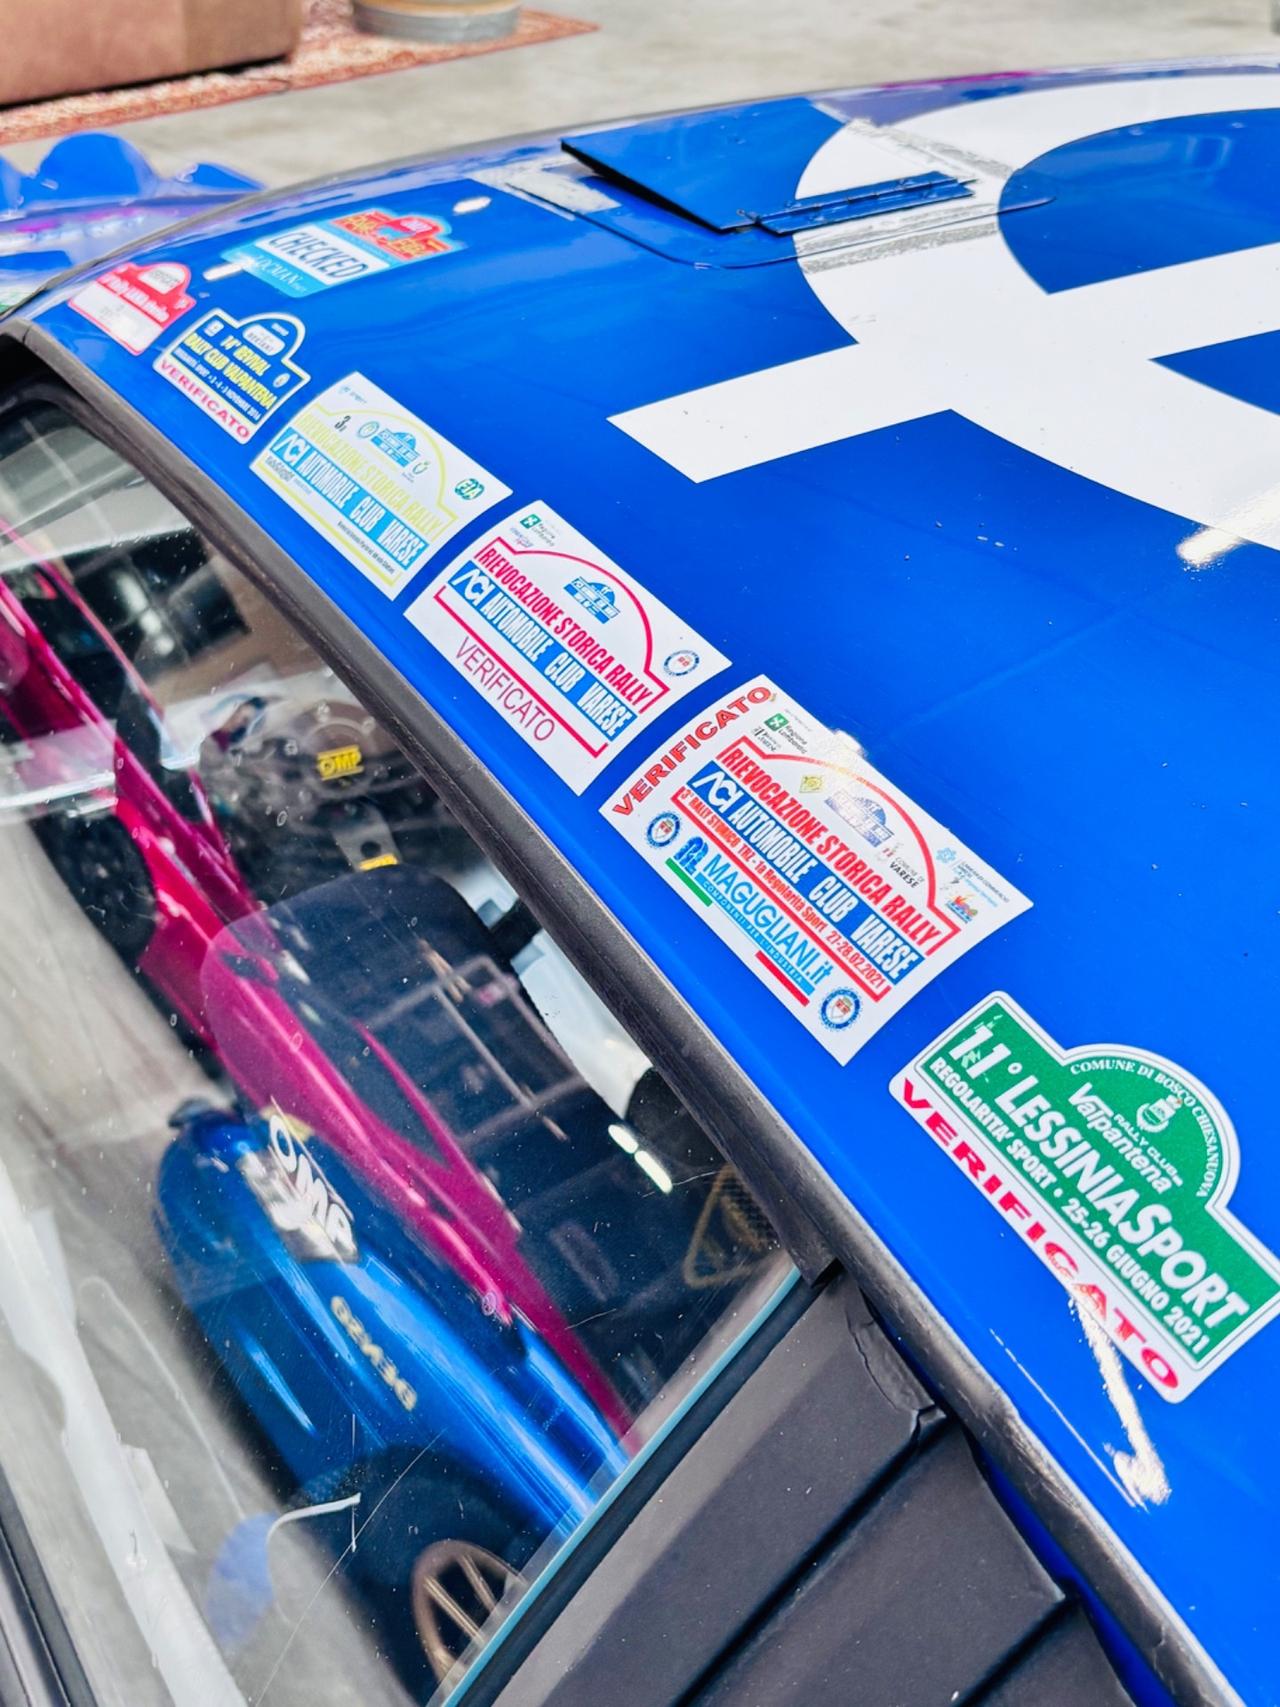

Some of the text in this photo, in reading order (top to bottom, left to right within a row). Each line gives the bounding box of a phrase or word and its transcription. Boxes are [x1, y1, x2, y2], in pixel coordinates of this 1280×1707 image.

[268, 232, 370, 279] CHECKED
[160, 359, 250, 438] VERIFICATO
[182, 331, 279, 410] RALLY CLUB VALPANTENA
[272, 431, 311, 466] ACI
[295, 450, 360, 509] AUTOMOBILE
[348, 494, 388, 534] CLUB
[375, 517, 424, 566] VARESE
[358, 462, 413, 511] STORICA
[401, 499, 443, 537] RALLY
[451, 568, 497, 607] ACI
[480, 591, 555, 663] AUTOMOBILE
[544, 652, 587, 694] CLUB
[576, 681, 633, 738] VARESE
[455, 635, 555, 742] VERIFICATO
[478, 548, 565, 626] RIEVOCAZIONE
[554, 617, 616, 675] STORICA
[605, 664, 653, 706] RALLY
[612, 686, 772, 816] VERIFICATO
[687, 797, 712, 821] RALLY
[800, 904, 829, 934] Sport
[825, 929, 887, 990] 27-28.02.2021
[692, 770, 745, 815] ACI
[728, 801, 819, 884] AUTOMOBILE
[808, 875, 859, 923] CLUB
[850, 913, 919, 981] VARESE
[722, 748, 829, 846] RIEVOCAZIONE
[816, 834, 894, 909] STORICA
[881, 894, 942, 952] RALLY
[889, 861, 921, 889] VARESE
[703, 853, 834, 985] MAGUGLIANI.it
[948, 1024, 1023, 1080] 11°
[1068, 1081, 1173, 1195] Valpantena
[1070, 1059, 1136, 1076] COMUNE
[1137, 1064, 1154, 1080] DI
[1154, 1075, 1197, 1108] BOSCO
[1191, 1106, 1220, 1198] CHIESANUOVA
[1113, 1114, 1178, 1177] RALLY CLUB
[904, 1077, 1179, 1389] VERIFICATO
[929, 1056, 1211, 1355] REGOLARITA' SPORT 25-26 GIUGNO 2021
